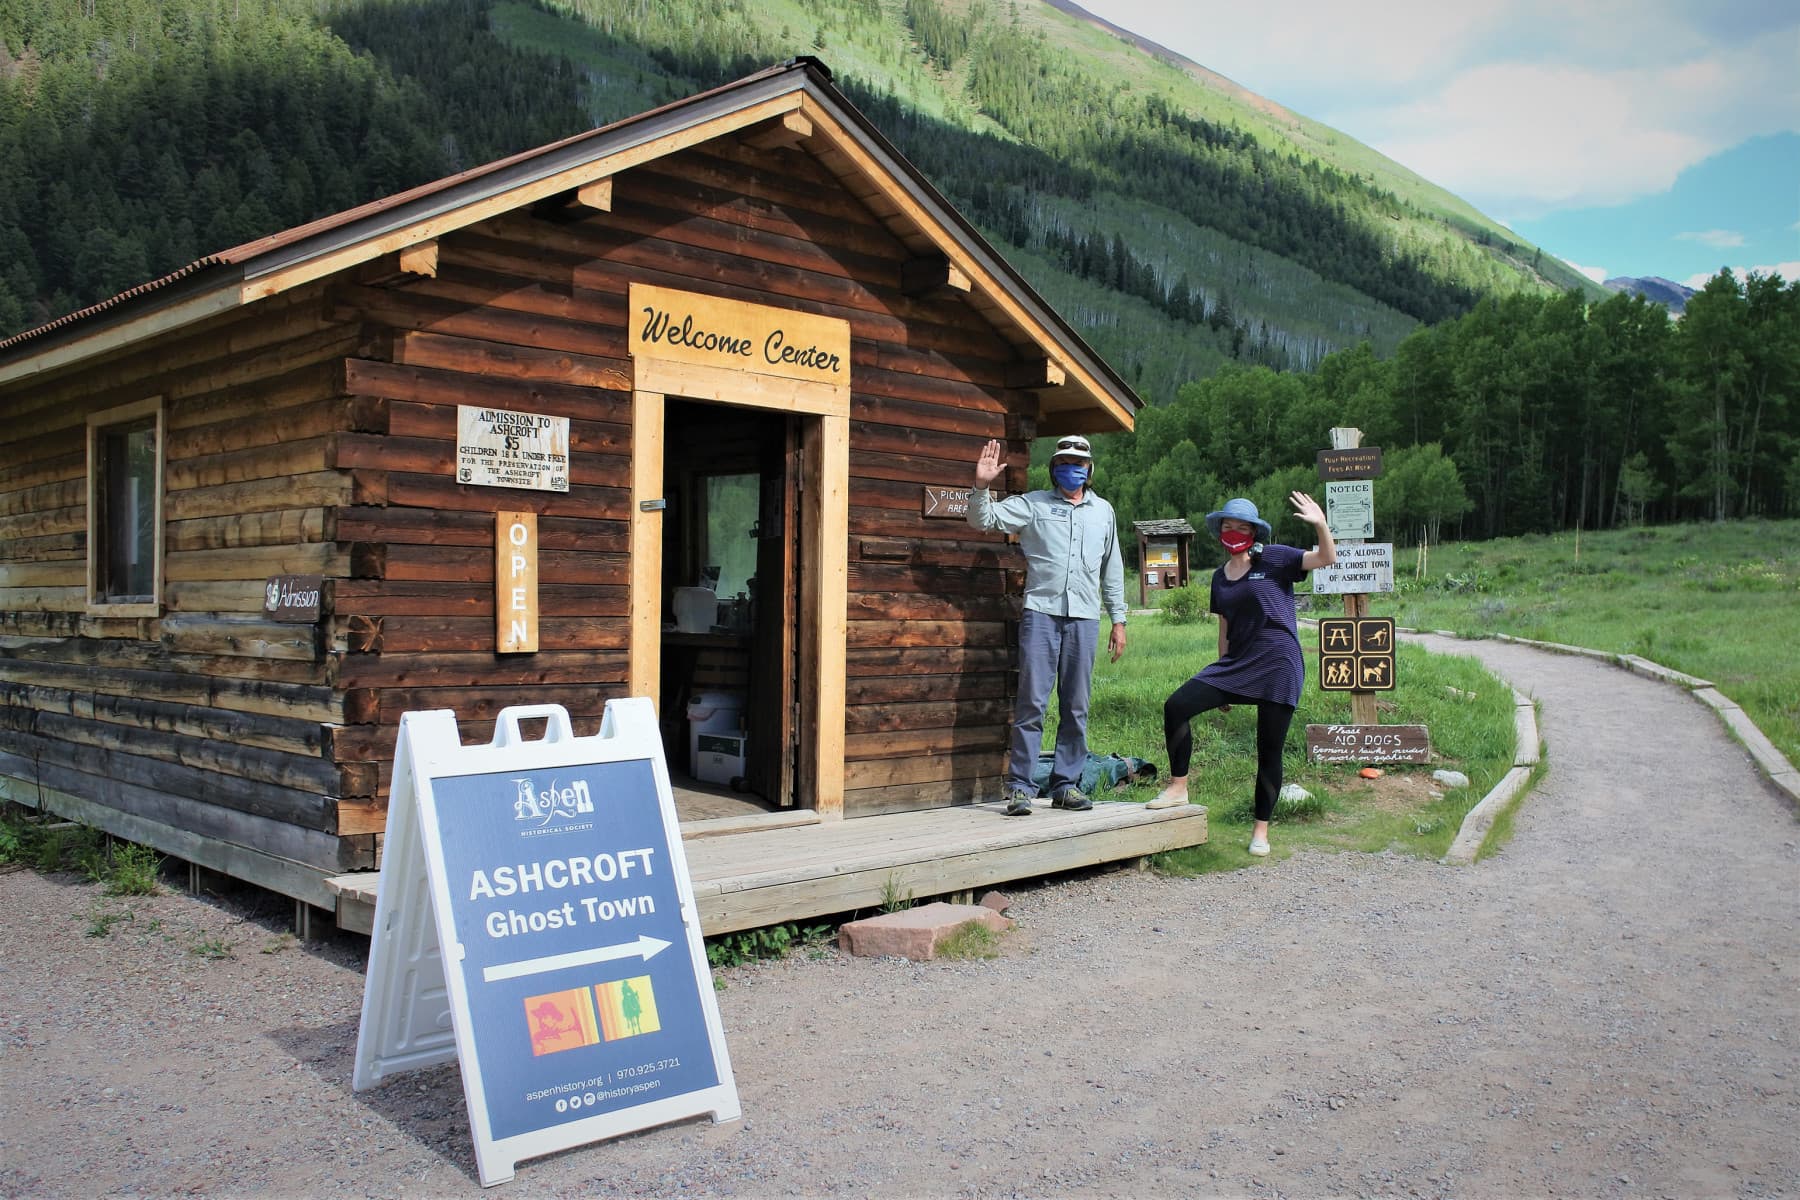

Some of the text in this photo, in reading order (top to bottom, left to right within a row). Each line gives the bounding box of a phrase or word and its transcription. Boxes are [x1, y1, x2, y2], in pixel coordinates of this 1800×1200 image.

[641, 306, 840, 372] Welcome Center
[478, 410, 551, 428] ADMISSION TO
[490, 424, 538, 438] ASHCROFT
[504, 435, 520, 450] $5
[459, 446, 498, 457] CHILDREN
[522, 451, 546, 461] UNDER
[547, 454, 566, 464] FREE
[461, 457, 476, 465] FOR
[498, 459, 551, 472] PRESERVATION
[487, 467, 541, 478] THE ASHCROFT
[496, 476, 532, 485] TOWNSITE
[940, 490, 969, 500] PICNIC
[1330, 484, 1369, 494] NOTICE
[1355, 548, 1386, 557] ALLOWED
[1330, 561, 1343, 570] THE
[1345, 561, 1368, 569] GHOST
[1371, 560, 1390, 569] TOWN
[508, 523, 529, 644] OPEN
[1329, 573, 1377, 582] OF ASHCROFT
[1334, 734, 1402, 746] NO DOGS
[511, 777, 594, 827] Aspen
[520, 823, 593, 837] HISTORICAL SOCIETY
[470, 847, 655, 901] ASHCROFT
[486, 894, 656, 938] Ghost Town
[525, 1075, 603, 1101] aspenhistory.org
[616, 1057, 681, 1080] 970.925.3721
[596, 1078, 661, 1101] @historyaspen
